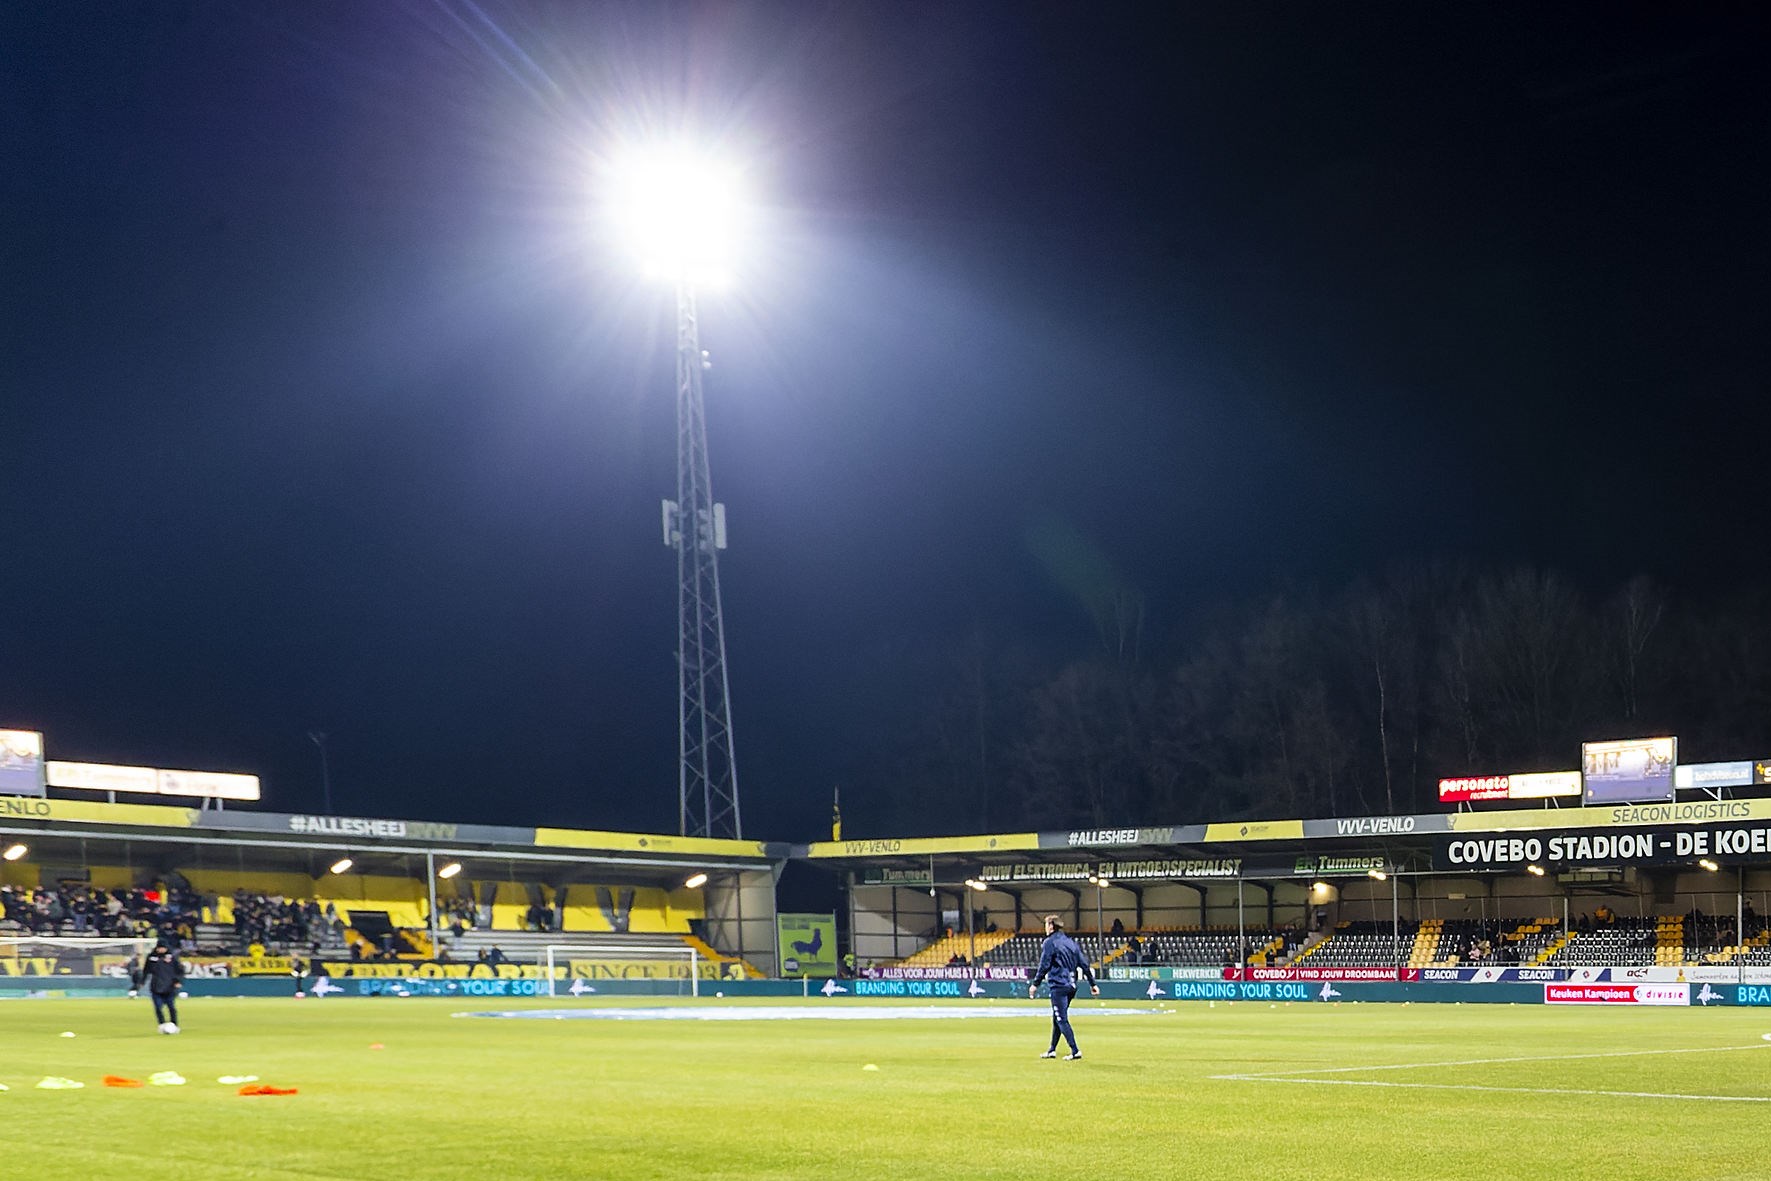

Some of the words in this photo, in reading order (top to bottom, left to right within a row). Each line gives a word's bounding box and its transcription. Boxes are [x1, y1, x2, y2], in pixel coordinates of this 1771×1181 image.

[1439, 776, 1508, 796] personato
[1612, 805, 1673, 823] SEACON
[1674, 802, 1750, 820] LOGISTICS
[1337, 816, 1414, 835] VVV-VENLO
[845, 840, 901, 854] VVV-VENLO
[1448, 838, 1542, 864] COVEBO
[1549, 834, 1652, 860] STADION
[1676, 832, 1710, 856] DE
[1319, 855, 1384, 869] Tummers
[1098, 863, 1114, 878] EN
[575, 963, 654, 980] SINCE
[1172, 968, 1221, 979] HEKWERKEN
[1253, 969, 1287, 979] COVEBO
[1300, 969, 1318, 979] VIND
[1321, 969, 1343, 979] JOUW
[1344, 969, 1396, 980] DROOMBAAN
[1424, 970, 1459, 980] SEACON
[1518, 970, 1554, 980] SEACON
[855, 982, 904, 995] BRANDING
[907, 982, 932, 995] YOUR
[934, 982, 960, 995] SOUL
[1175, 983, 1235, 998] BRANDING
[1240, 984, 1271, 998] YOUR
[1276, 985, 1308, 998] SOUL
[1550, 988, 1583, 999] Keuken
[1585, 988, 1630, 1001] Kampioen
